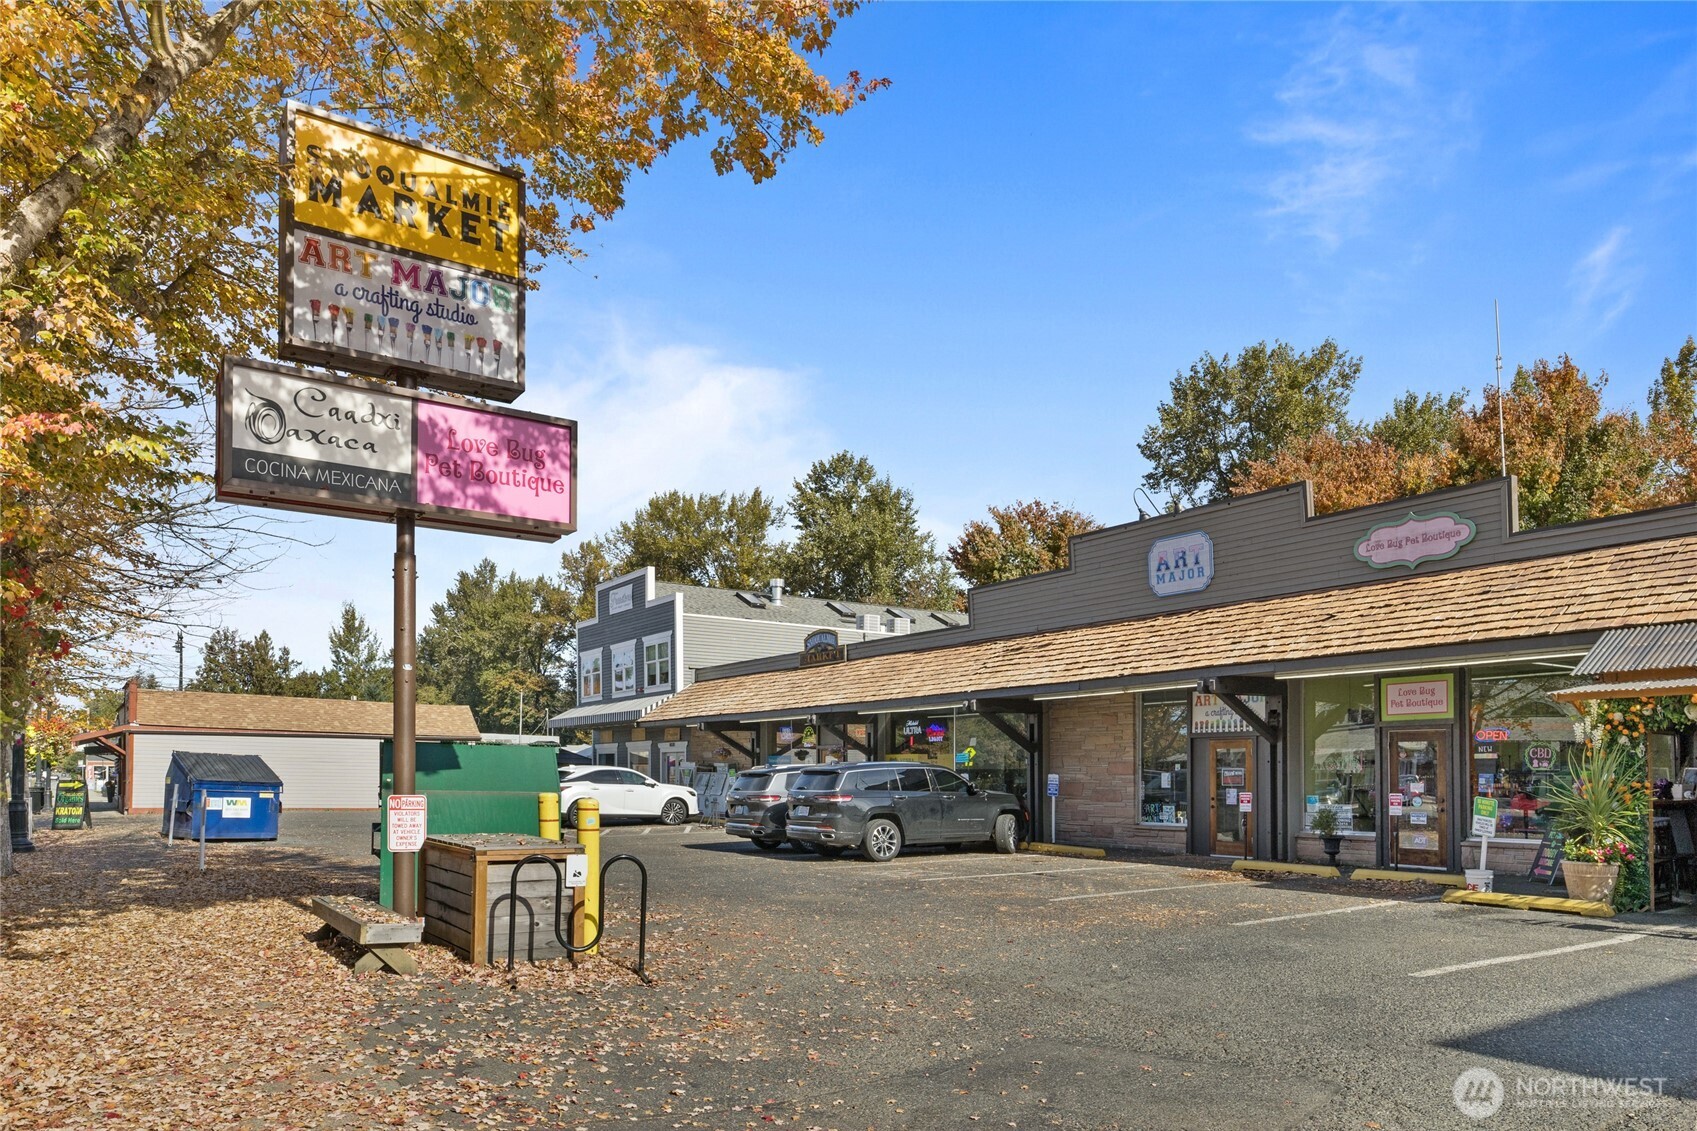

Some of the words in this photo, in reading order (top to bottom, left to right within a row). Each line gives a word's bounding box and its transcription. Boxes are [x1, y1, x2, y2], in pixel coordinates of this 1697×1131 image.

[307, 172, 509, 252] MARKET
[299, 236, 378, 279] ART
[391, 258, 513, 312] MAJOR
[334, 283, 348, 297] a
[353, 285, 423, 323] crafting
[426, 299, 478, 326] studio
[245, 388, 378, 453] Oaxaca
[293, 387, 401, 430] Caadxi
[447, 427, 498, 456] Love
[507, 438, 546, 470] Bug
[245, 457, 311, 481] COCINA
[315, 468, 402, 494] MEXICANA
[425, 453, 462, 479] Pet
[470, 460, 565, 497] Boutique
[1366, 543, 1384, 553] Love
[1387, 539, 1403, 549] Bug
[1405, 536, 1419, 546] Pet
[1421, 529, 1461, 543] Boutique
[1156, 543, 1205, 572] ART
[1156, 566, 1205, 585] MAJOR
[1390, 699, 1404, 708] Pet
[1406, 698, 1444, 709] Boutique
[1398, 687, 1417, 697] Love
[1419, 686, 1436, 696] Bug
[903, 726, 922, 735] ULTRA
[1476, 730, 1508, 741] OPEN
[1529, 748, 1552, 758] CBD
[56, 806, 83, 815] KRATOM
[390, 799, 400, 808] NO
